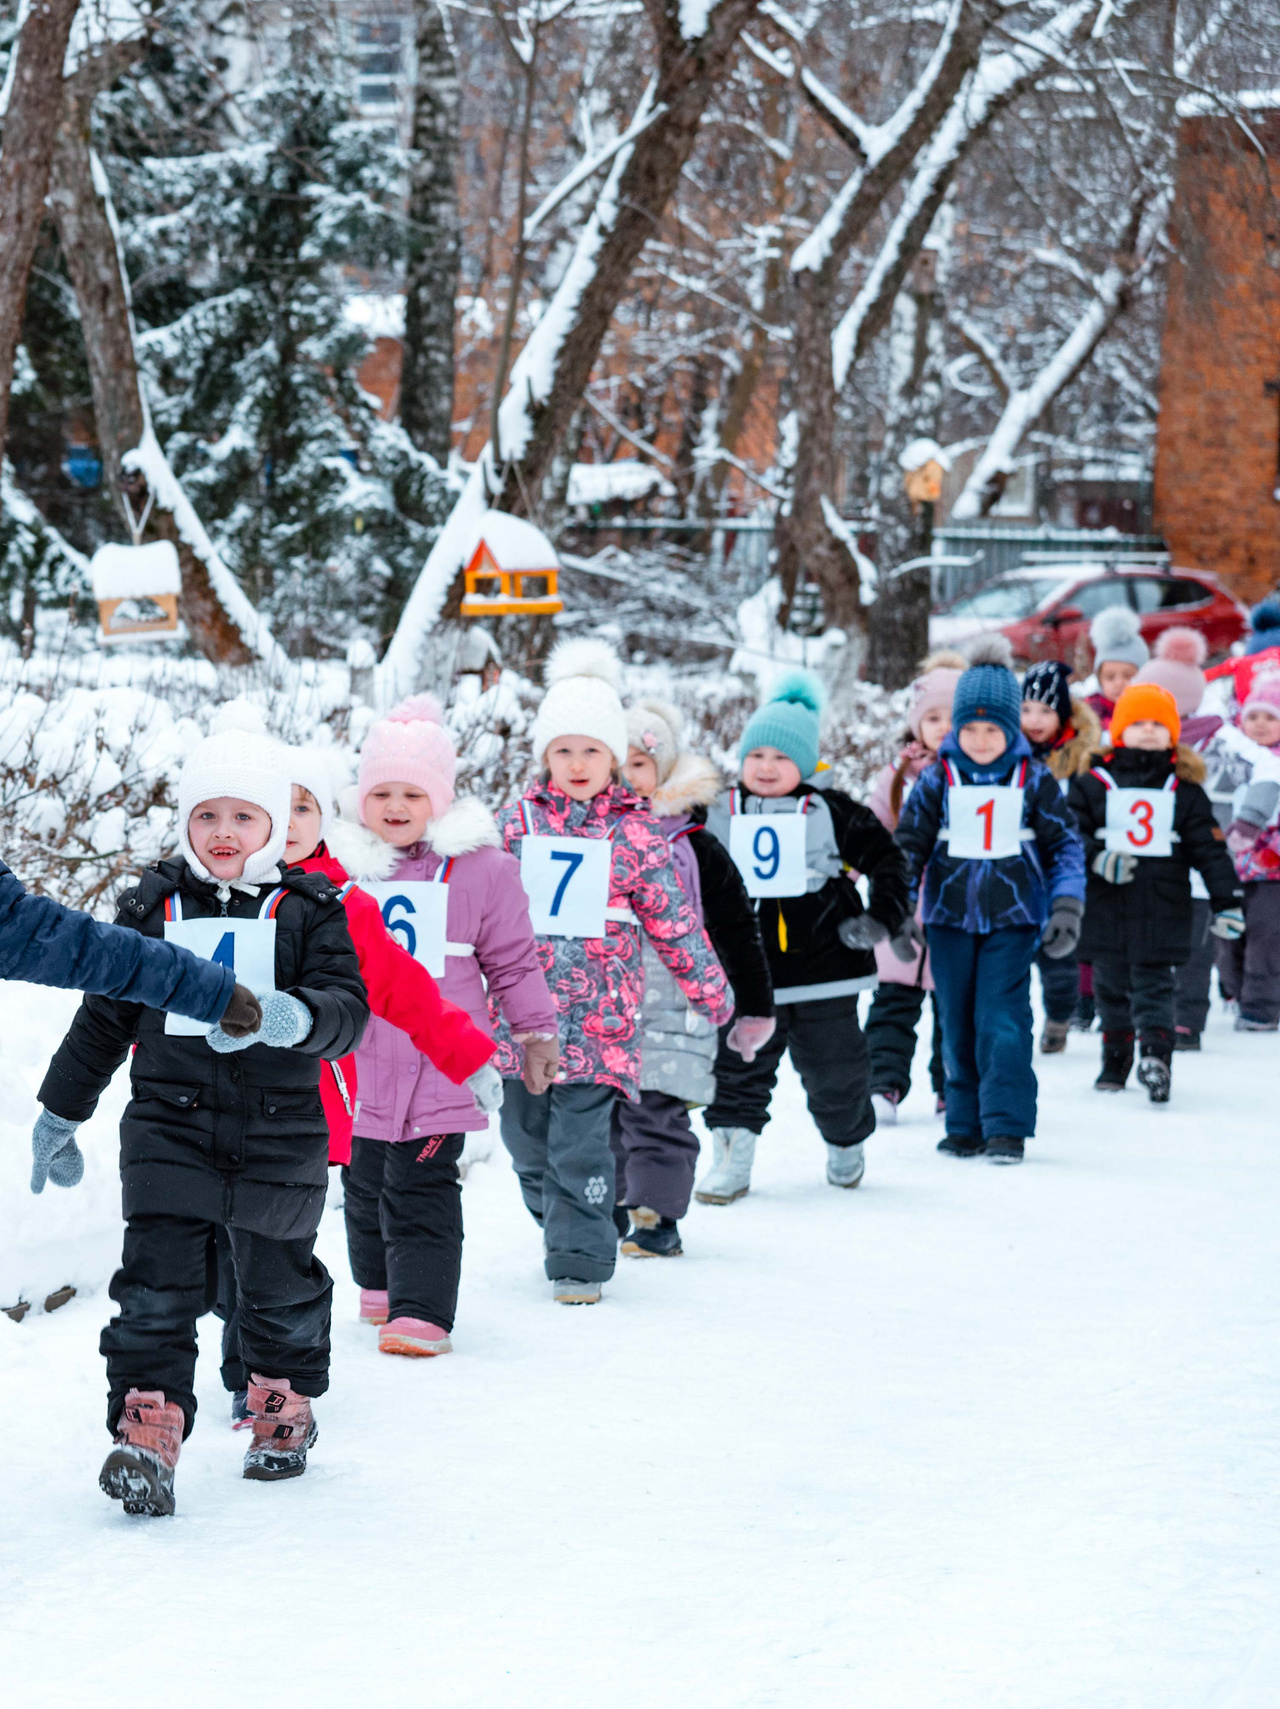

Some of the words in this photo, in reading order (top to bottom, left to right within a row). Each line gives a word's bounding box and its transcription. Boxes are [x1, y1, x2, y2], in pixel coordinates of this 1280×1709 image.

[976, 799, 995, 851] 1
[1126, 799, 1154, 847] 3
[752, 826, 780, 881] 9
[549, 850, 584, 917] 7
[381, 894, 417, 957] 6
